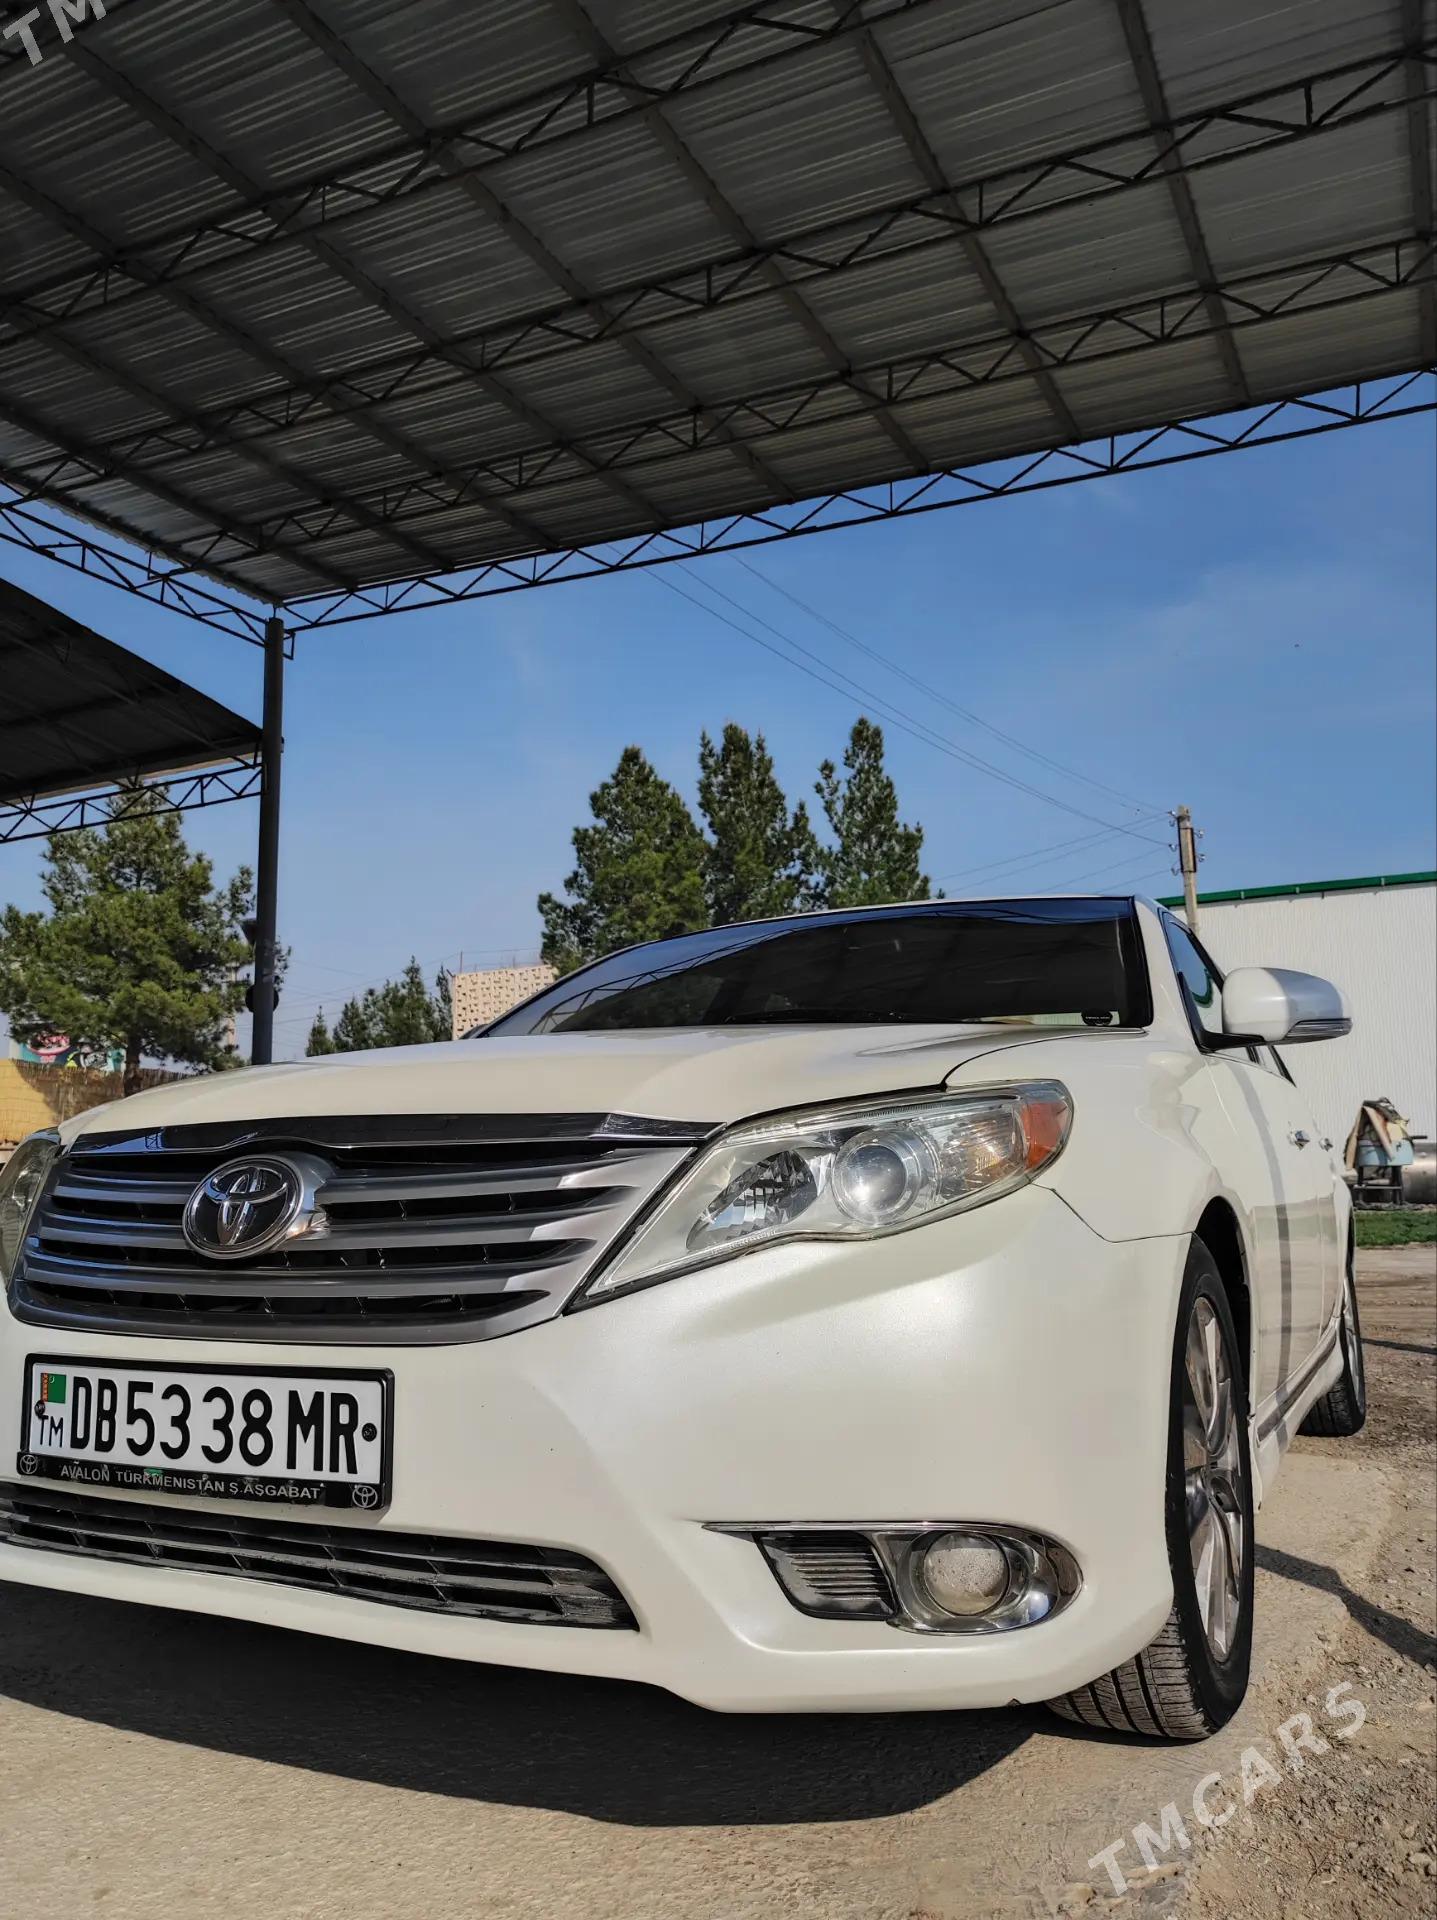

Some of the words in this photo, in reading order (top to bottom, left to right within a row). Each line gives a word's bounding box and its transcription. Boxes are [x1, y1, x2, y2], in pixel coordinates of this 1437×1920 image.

[38, 1414, 64, 1448] TM
[60, 1464, 110, 1482] AVALON
[115, 1470, 225, 1492] TÜRKMENISTAN
